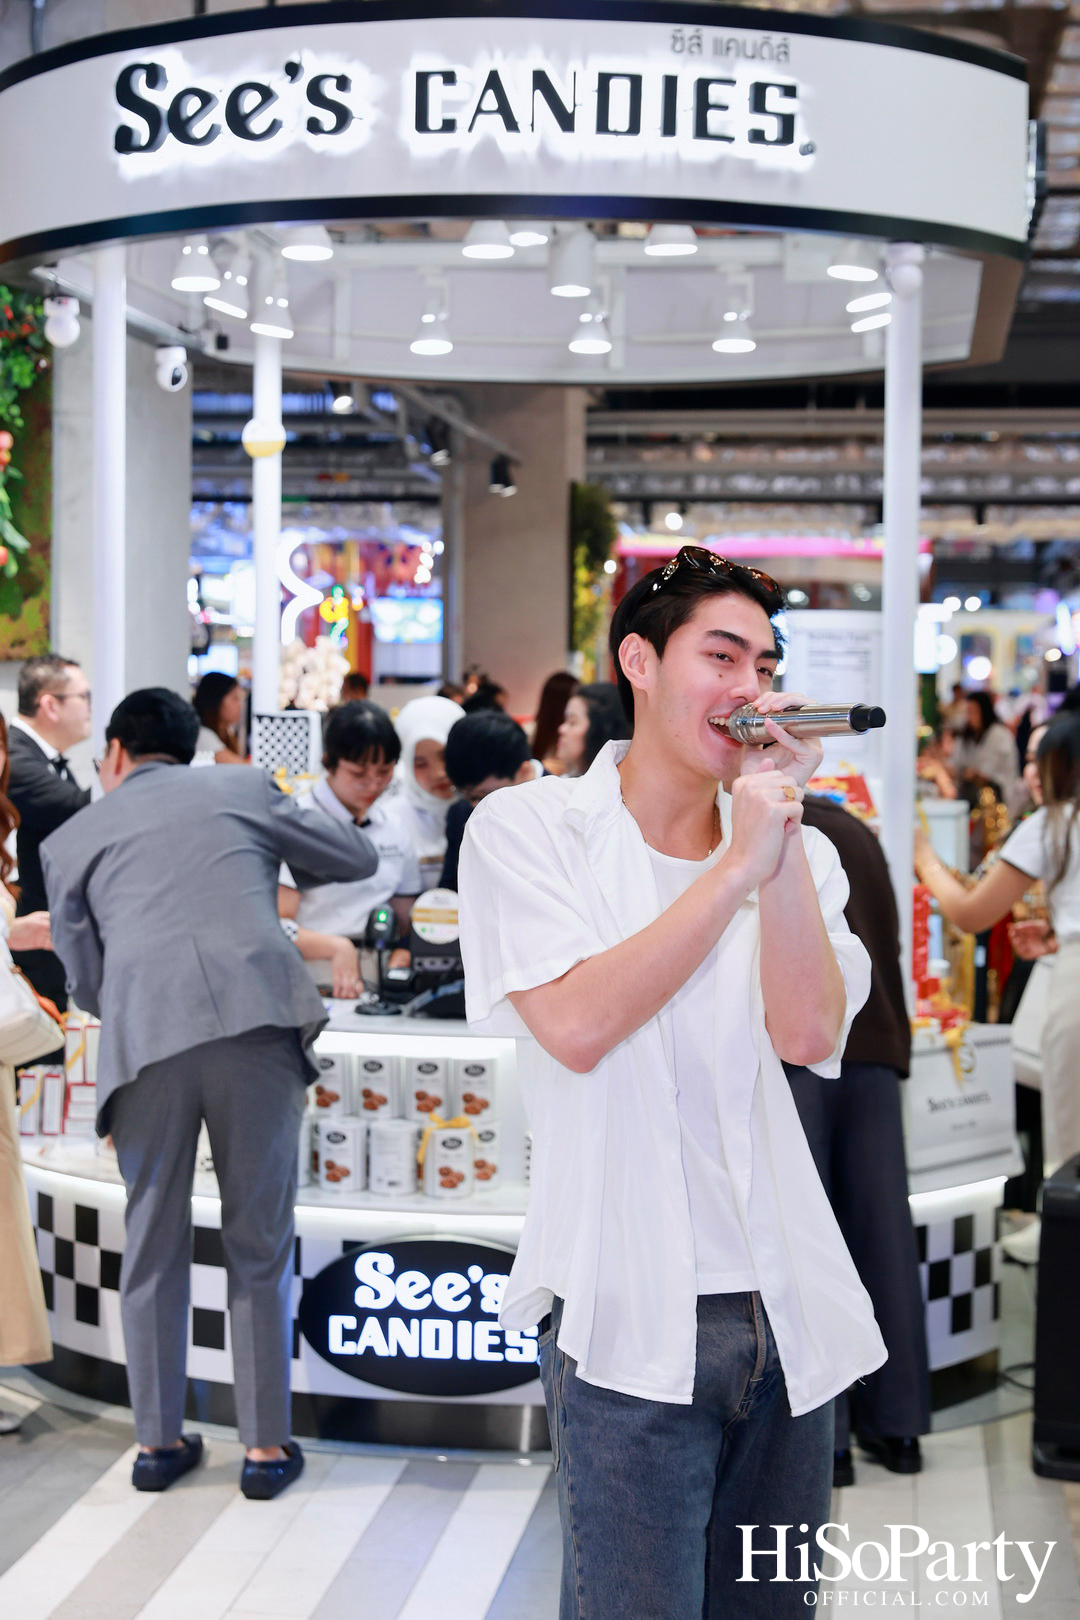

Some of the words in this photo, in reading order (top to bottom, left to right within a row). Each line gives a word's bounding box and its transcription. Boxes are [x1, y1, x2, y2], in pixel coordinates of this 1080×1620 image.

[114, 60, 352, 155] See's
[414, 69, 797, 147] CANDIES
[354, 1251, 509, 1314] See's
